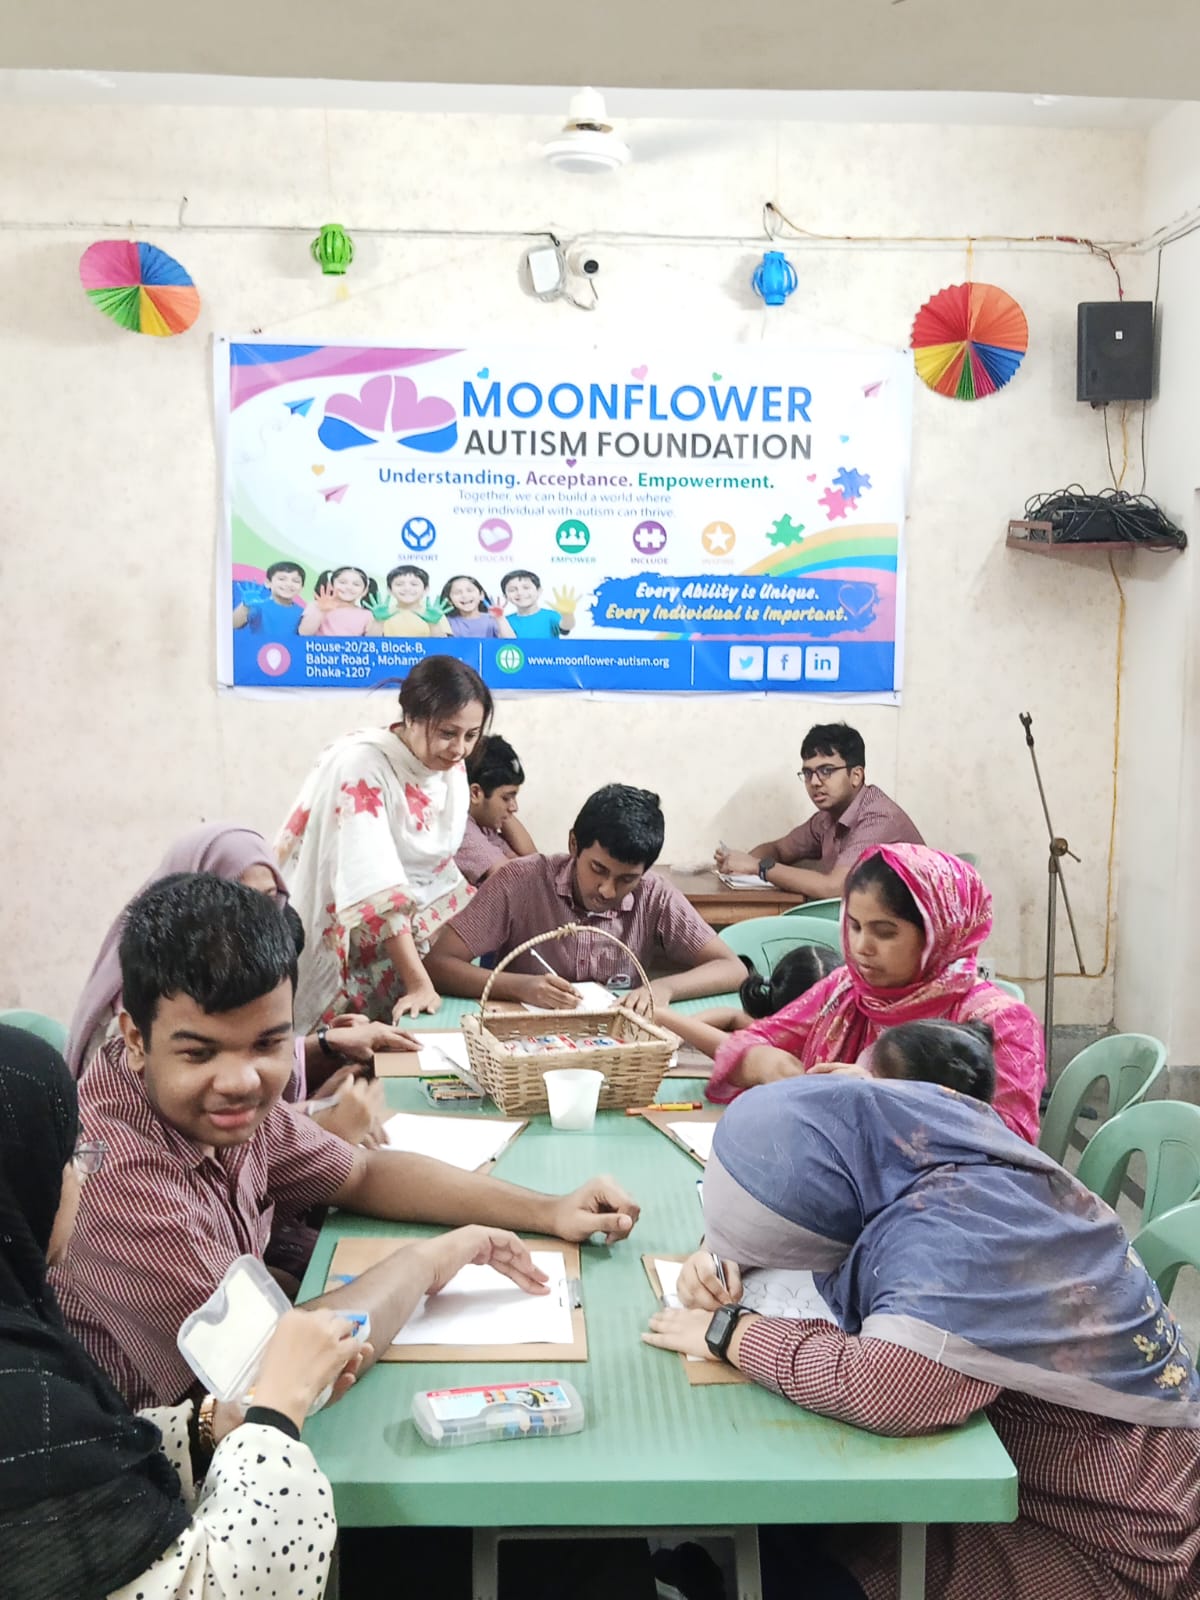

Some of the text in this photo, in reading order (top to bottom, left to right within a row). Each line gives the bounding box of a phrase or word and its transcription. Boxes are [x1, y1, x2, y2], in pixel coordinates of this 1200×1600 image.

[463, 381, 812, 422] MOONFLOWER
[464, 429, 811, 460] AUTISM FOUNDATION
[379, 468, 775, 491] Understanding. Acceptance. Empowerment.
[515, 493, 531, 501] we
[535, 492, 555, 501] can
[558, 490, 588, 502] build
[599, 491, 633, 503] world
[636, 493, 671, 504] where
[453, 506, 485, 517] every
[488, 505, 545, 516] individual
[547, 505, 573, 516] with
[576, 506, 615, 517] autism
[617, 508, 637, 517] can
[398, 553, 439, 562] SUPPORT
[551, 556, 596, 564] EMPOWER
[630, 557, 668, 565] INCLUDE
[635, 582, 820, 604] Every Ability is Unique.
[606, 604, 849, 626] Every Individual is Important.
[306, 641, 426, 655] House-20/28, Block-B,
[306, 654, 338, 665] Babar
[341, 654, 370, 665] Road
[528, 655, 670, 669] www.moonflower-autism.org
[813, 653, 832, 671] in
[306, 665, 372, 678] Dhaka-1207
